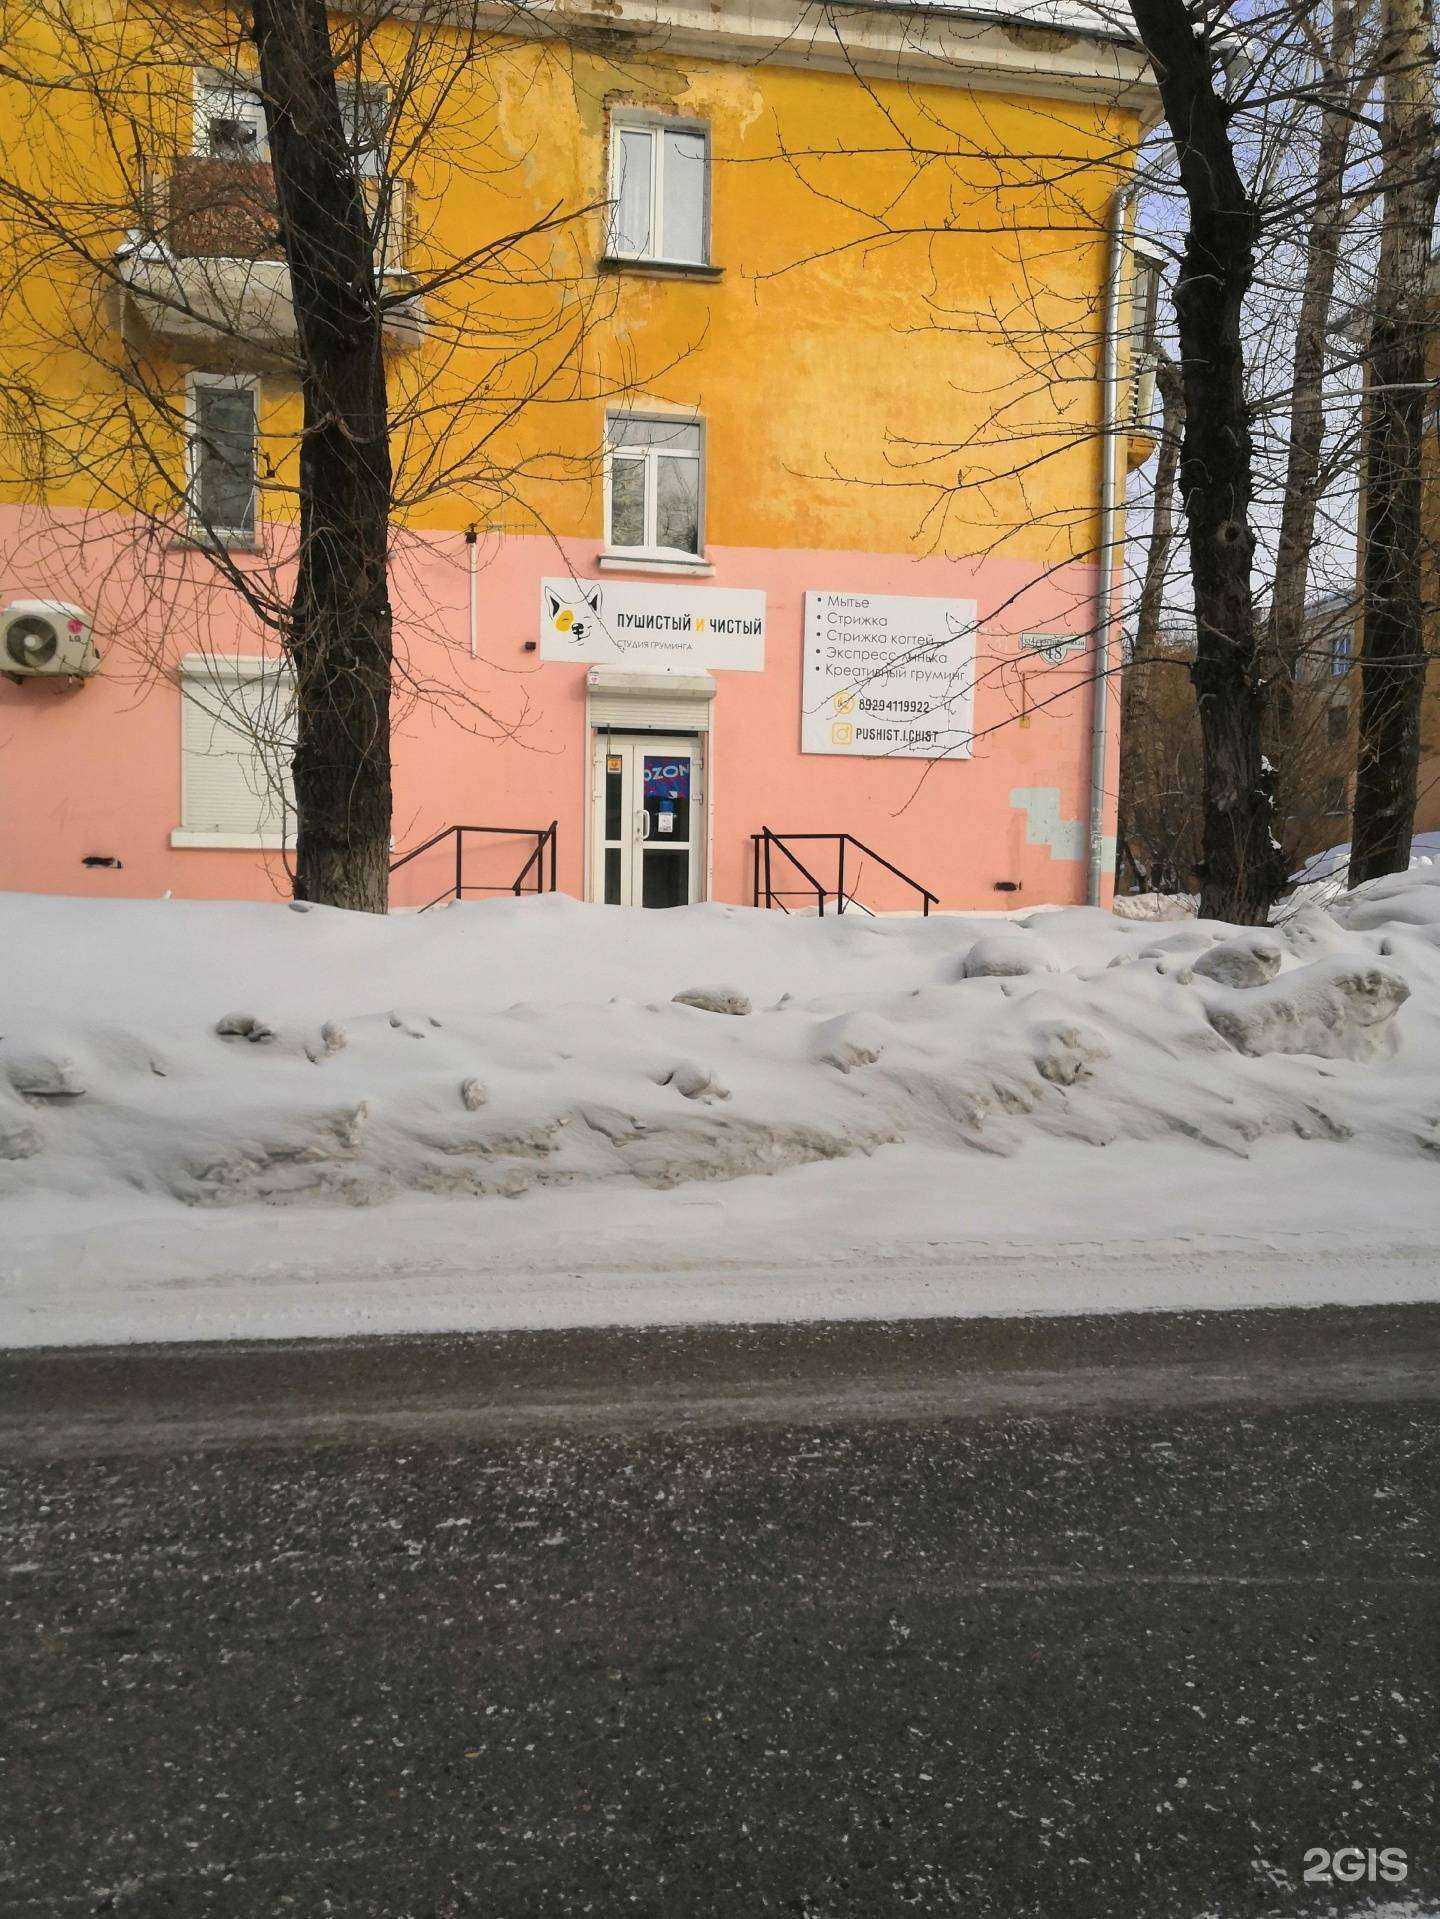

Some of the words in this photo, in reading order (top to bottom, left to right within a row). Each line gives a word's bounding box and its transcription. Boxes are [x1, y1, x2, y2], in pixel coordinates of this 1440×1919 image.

[827, 595, 870, 609] Мытье
[617, 612, 691, 631] ПУШИСТЫЙ
[695, 619, 706, 631] И
[710, 617, 762, 635] ЧИСТЫЙ
[827, 611, 888, 627] Стрижка
[69, 635, 81, 643] LG
[616, 639, 649, 649] СТУДИЯ
[650, 640, 694, 650] ГРУМИНГА
[826, 629, 887, 644] Стрижка
[891, 634, 934, 646] когтей
[826, 646, 897, 662] Экспресс
[910, 670, 965, 683] груминг
[858, 698, 930, 713] 89294119922
[856, 728, 938, 743] PUSHIST.I.CHIST
